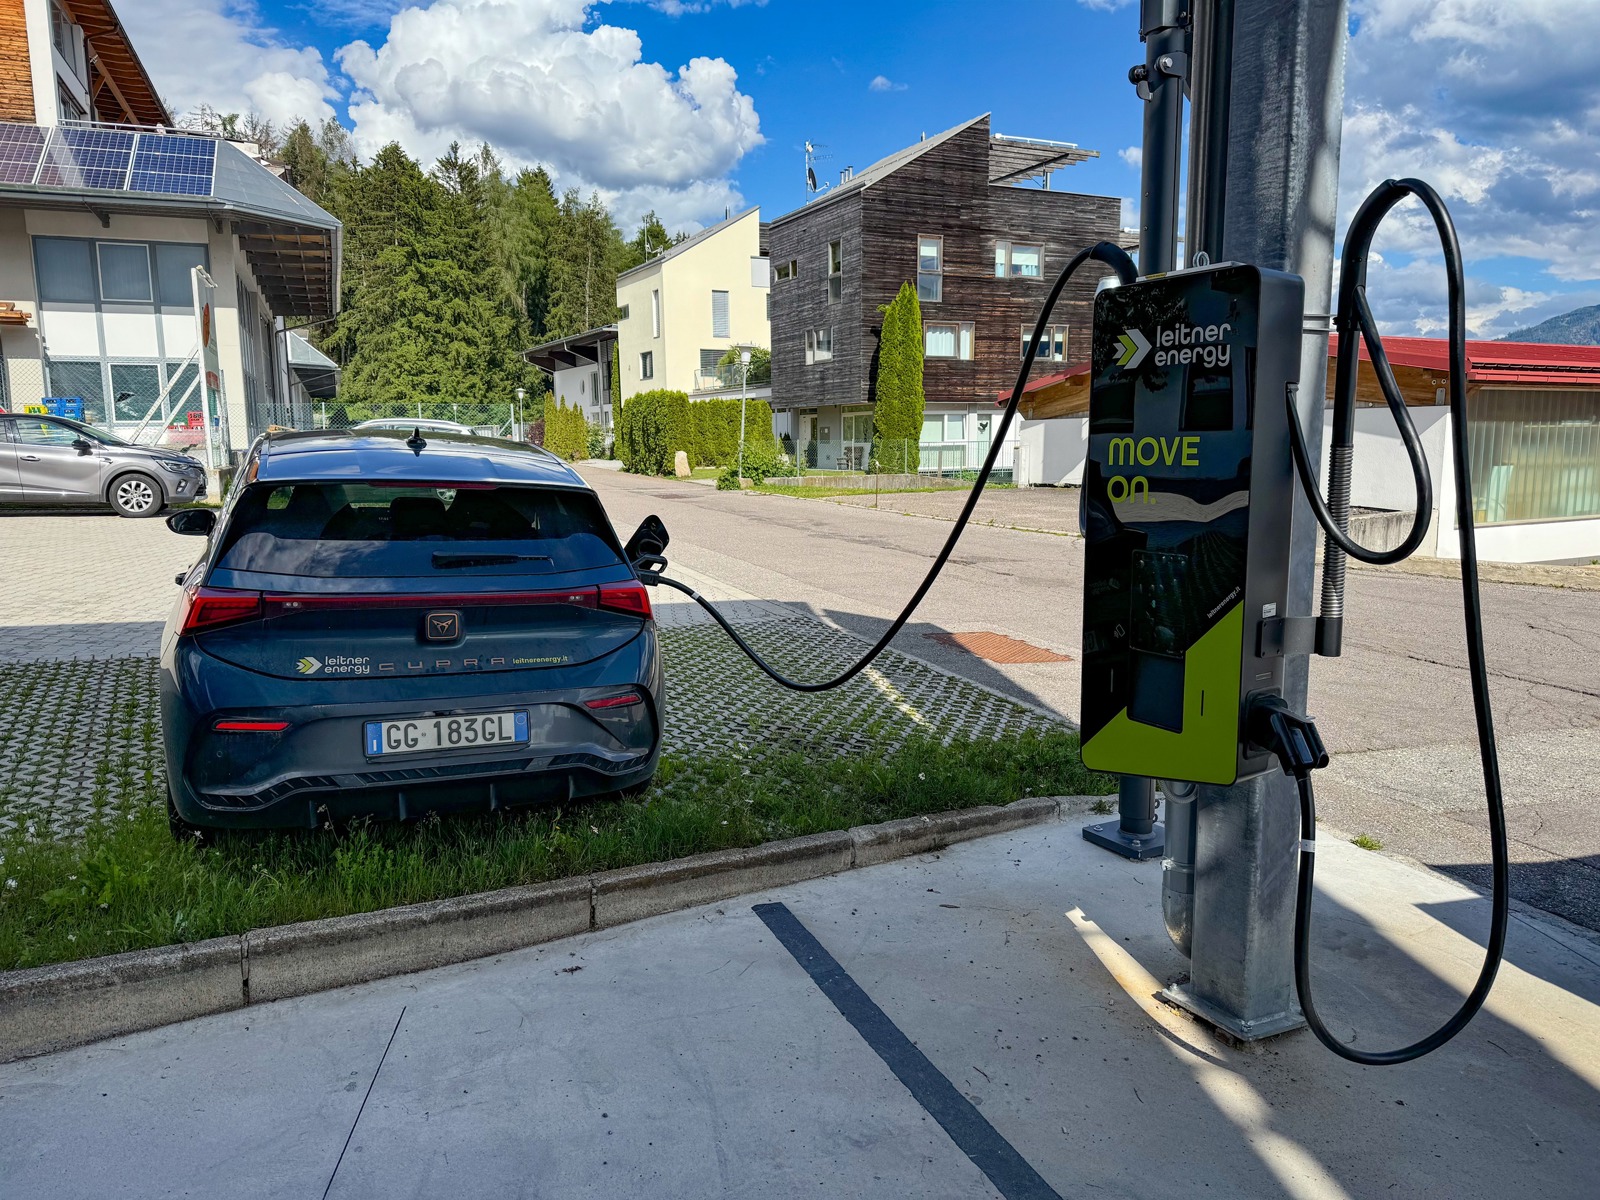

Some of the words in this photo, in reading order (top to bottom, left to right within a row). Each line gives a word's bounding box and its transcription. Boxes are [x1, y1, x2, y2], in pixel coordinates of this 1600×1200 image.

[1156, 323, 1231, 348] leitner
[1154, 344, 1231, 368] energy
[1108, 436, 1200, 466] MOVE
[324, 664, 370, 675] energy
[325, 656, 370, 666] leitner
[378, 657, 506, 671] CUPRA
[512, 655, 569, 665] leitnerenergy.it
[386, 723, 419, 750] GG
[433, 716, 512, 747] 183GL
